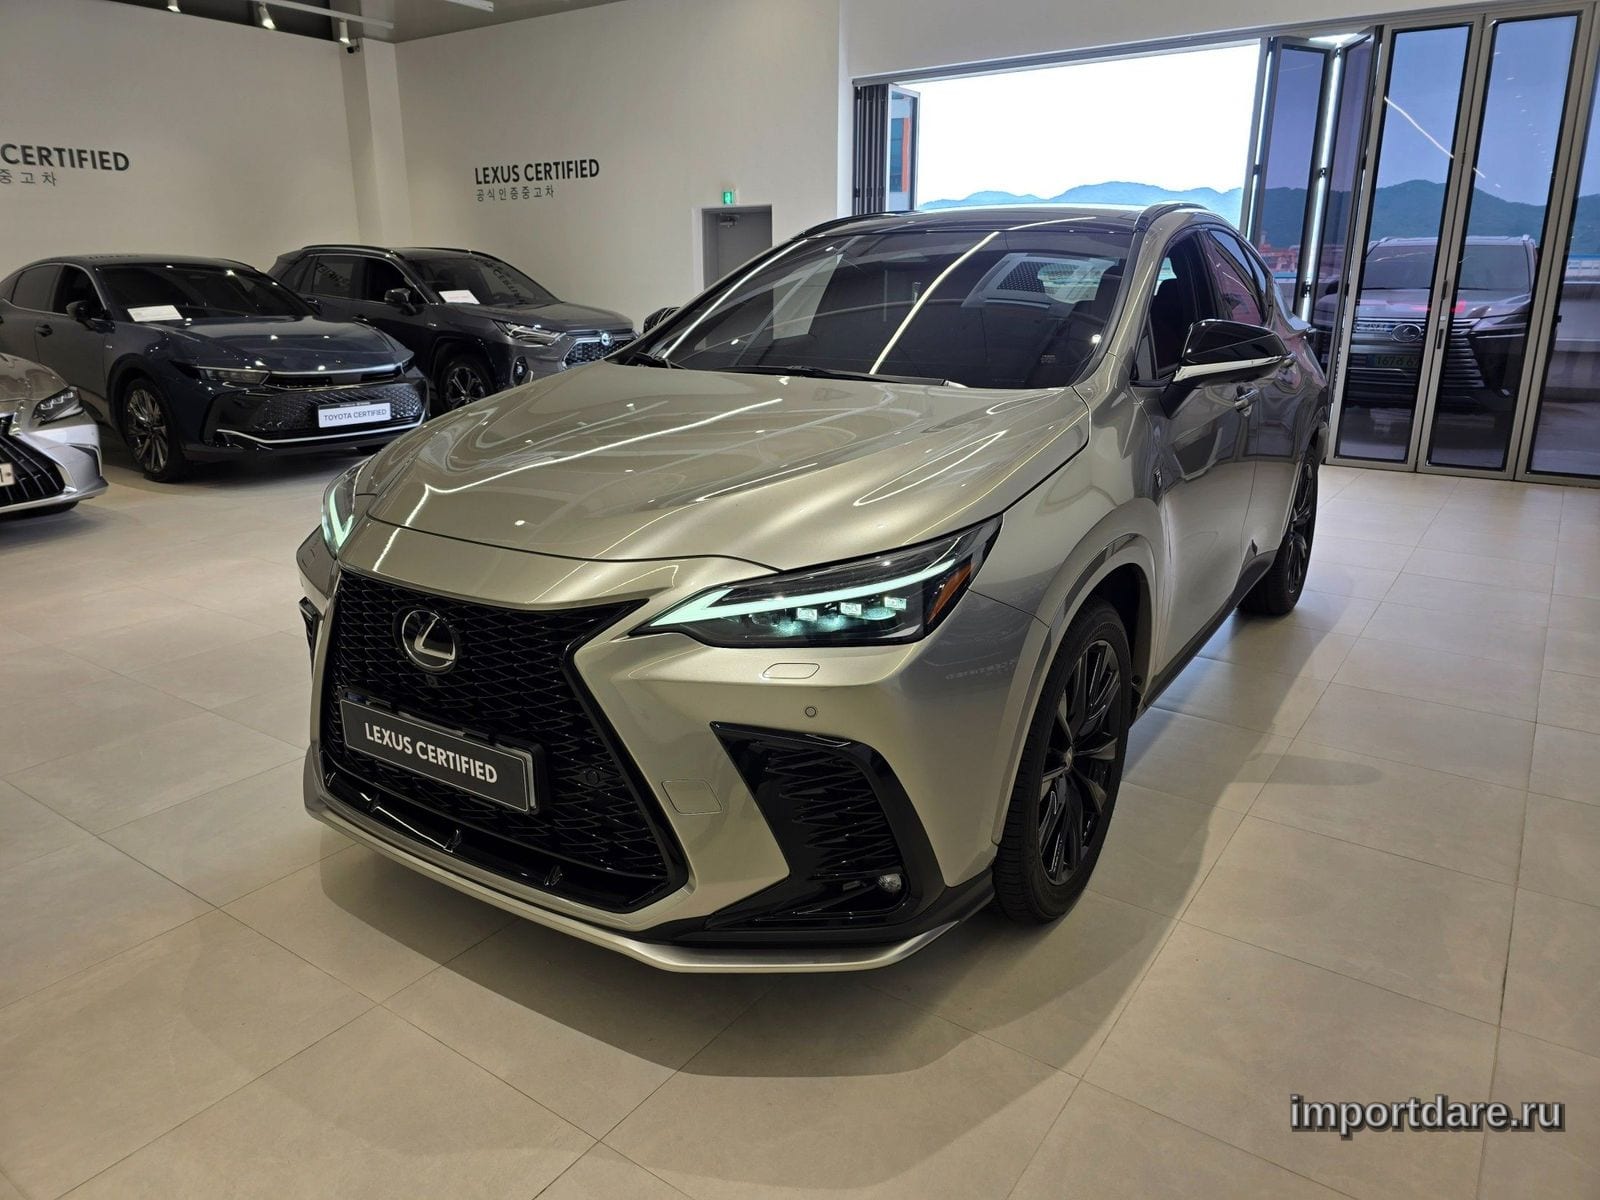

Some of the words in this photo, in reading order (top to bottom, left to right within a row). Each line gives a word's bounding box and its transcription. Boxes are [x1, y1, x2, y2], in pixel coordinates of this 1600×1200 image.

[0, 143, 130, 172] CERTIFIED
[474, 164, 520, 185] LEXUS
[523, 158, 600, 182] CERTIFIED
[476, 184, 554, 202] 공식인증중고차
[324, 412, 352, 421] TOYOTA
[353, 408, 387, 418] CERTIFIED
[364, 722, 413, 755] LEXUS
[415, 741, 498, 784] CERTIFIED
